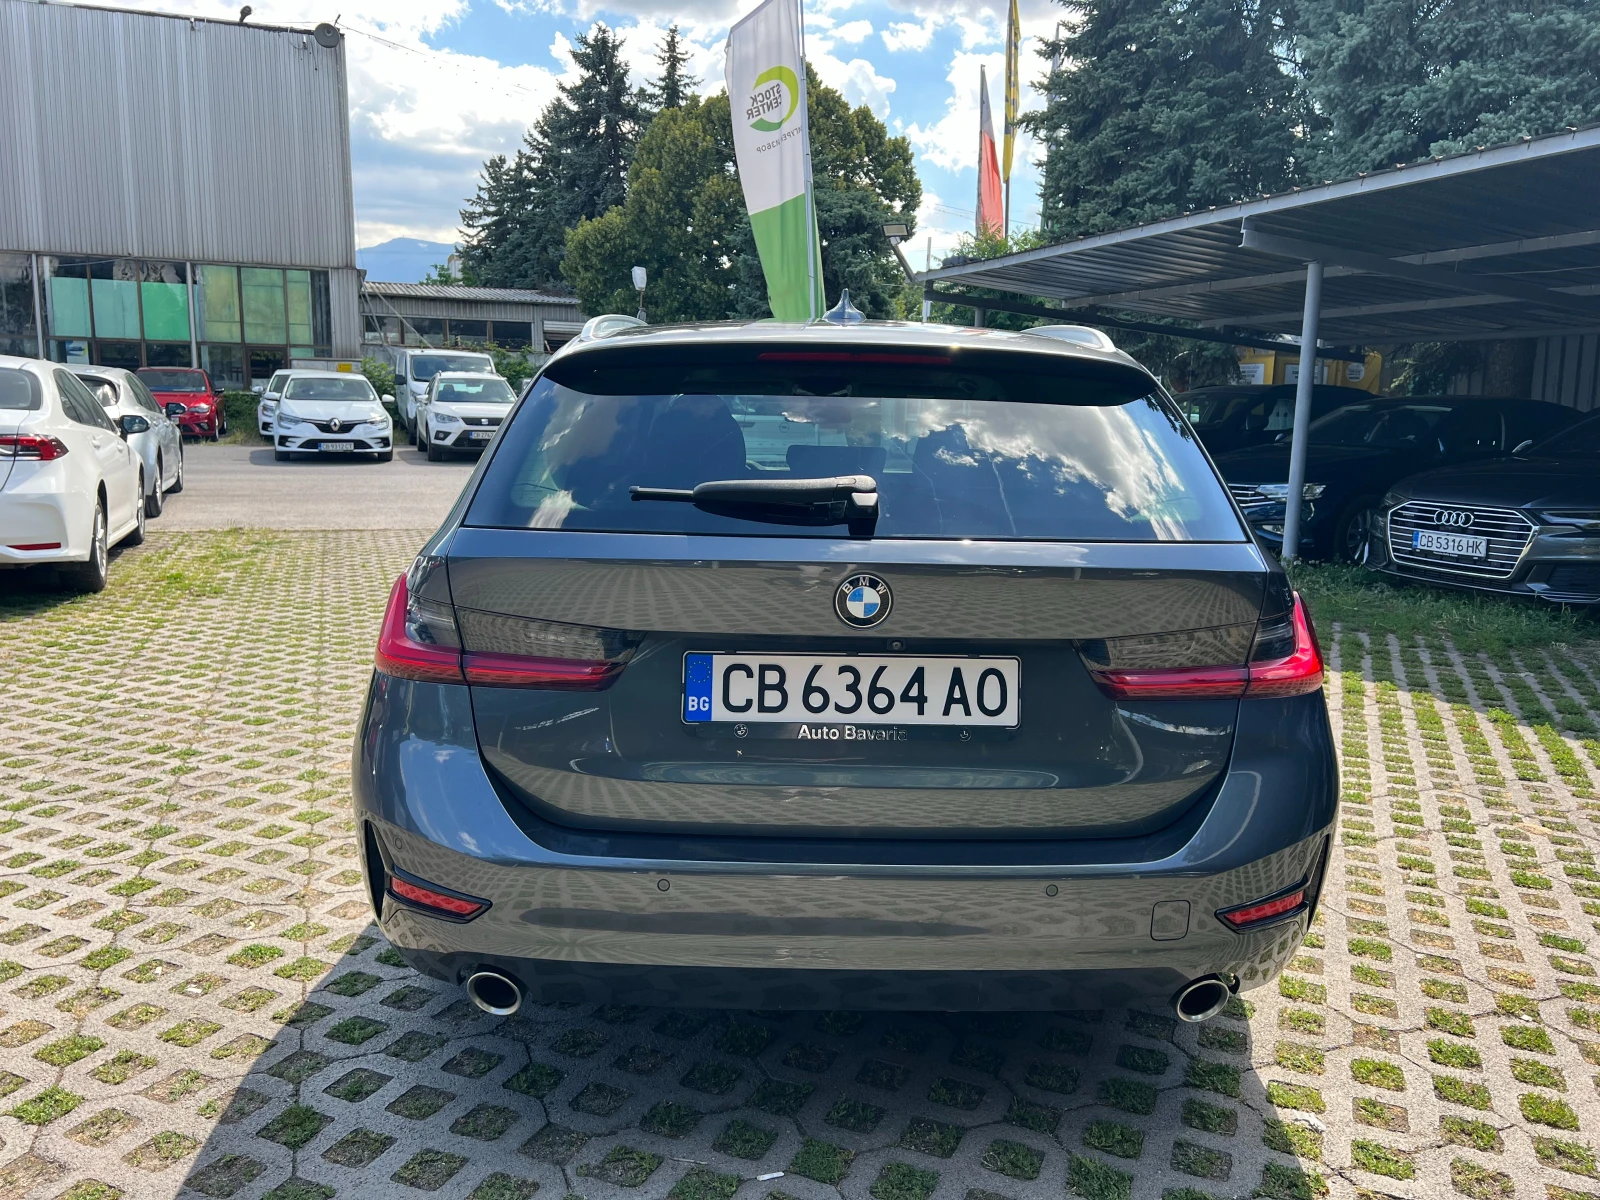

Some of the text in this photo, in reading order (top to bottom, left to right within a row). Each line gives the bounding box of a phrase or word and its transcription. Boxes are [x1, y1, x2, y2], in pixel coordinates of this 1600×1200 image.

[1420, 534, 1434, 548] CB
[1435, 536, 1464, 552] 5316
[1466, 540, 1483, 554] HK
[842, 576, 887, 595] BMW
[722, 663, 789, 714] CB
[802, 664, 928, 716] 6364
[688, 696, 710, 711] BG
[798, 724, 908, 741] Auto Bavaria
